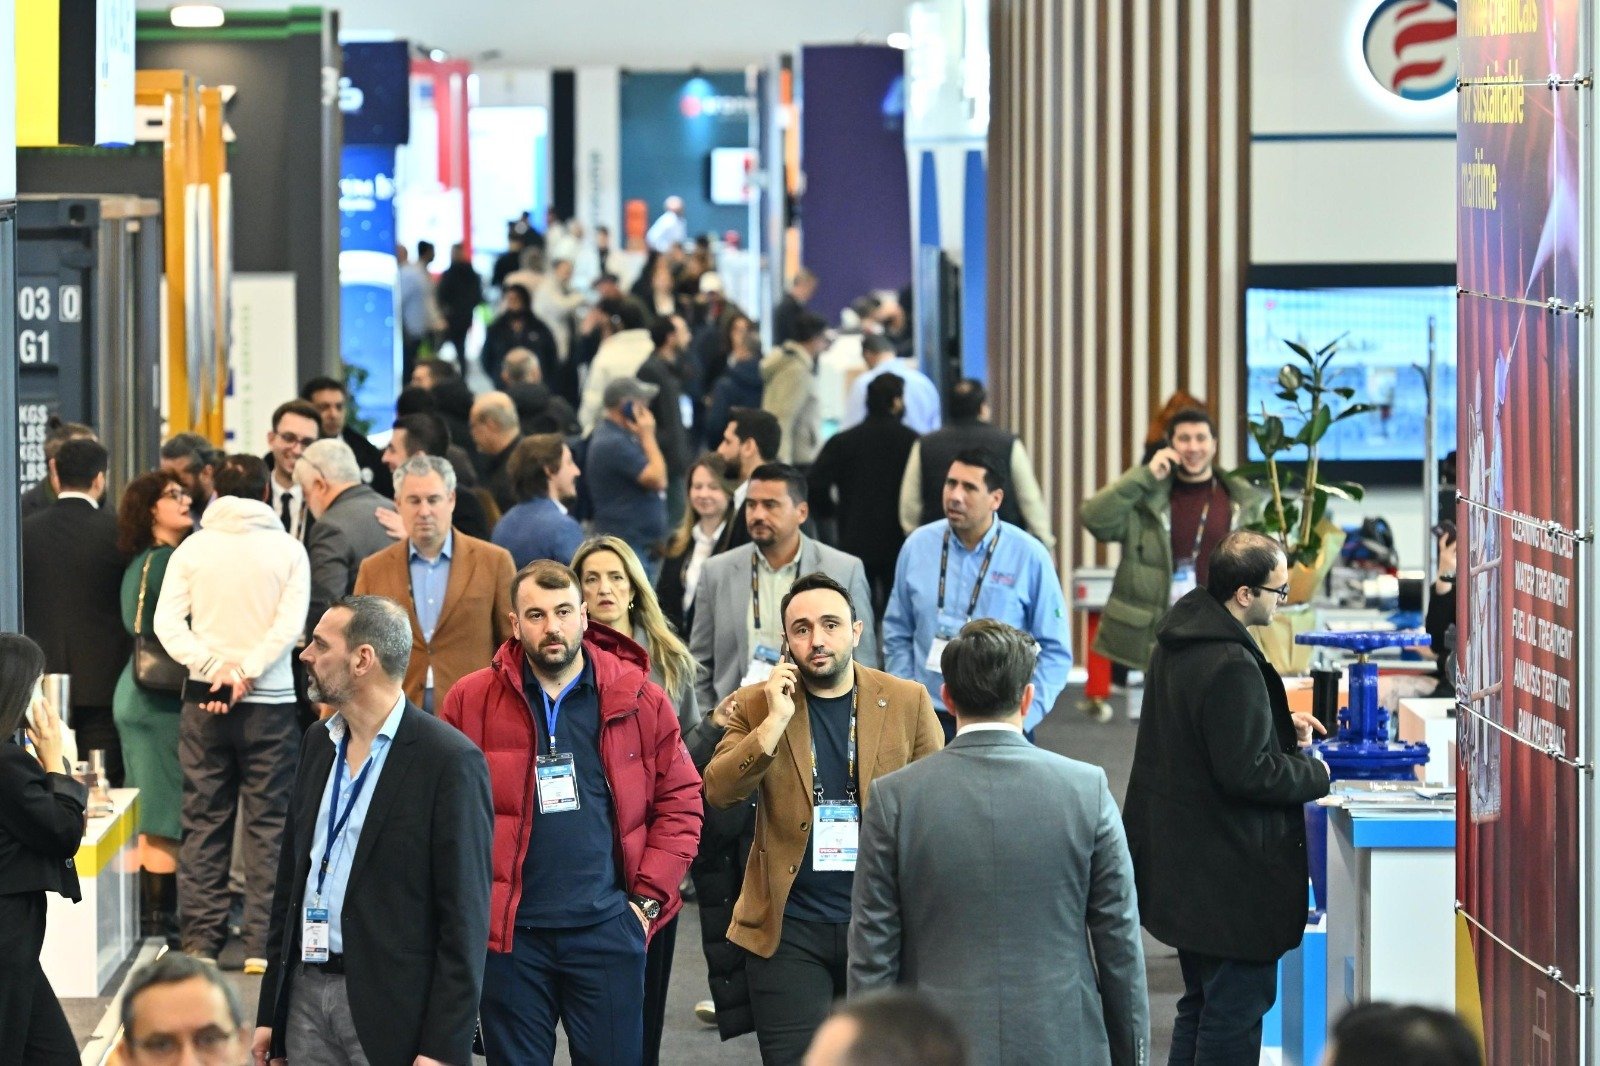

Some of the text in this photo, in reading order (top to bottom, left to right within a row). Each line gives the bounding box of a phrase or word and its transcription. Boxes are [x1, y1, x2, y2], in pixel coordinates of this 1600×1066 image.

[1473, 59, 1525, 124] sustainable
[1461, 147, 1497, 210] maritime
[19, 286, 79, 321] 03 0
[19, 329, 50, 363] G1
[19, 424, 47, 444] LBS
[1511, 510, 1540, 548] CLEANING
[1515, 560, 1570, 608] WATER TREATMENT
[1511, 607, 1573, 661] FUEL OIL TREATMENT
[1541, 669, 1557, 704] TEST
[1557, 676, 1571, 710] KITS
[1518, 707, 1533, 743] RAW
